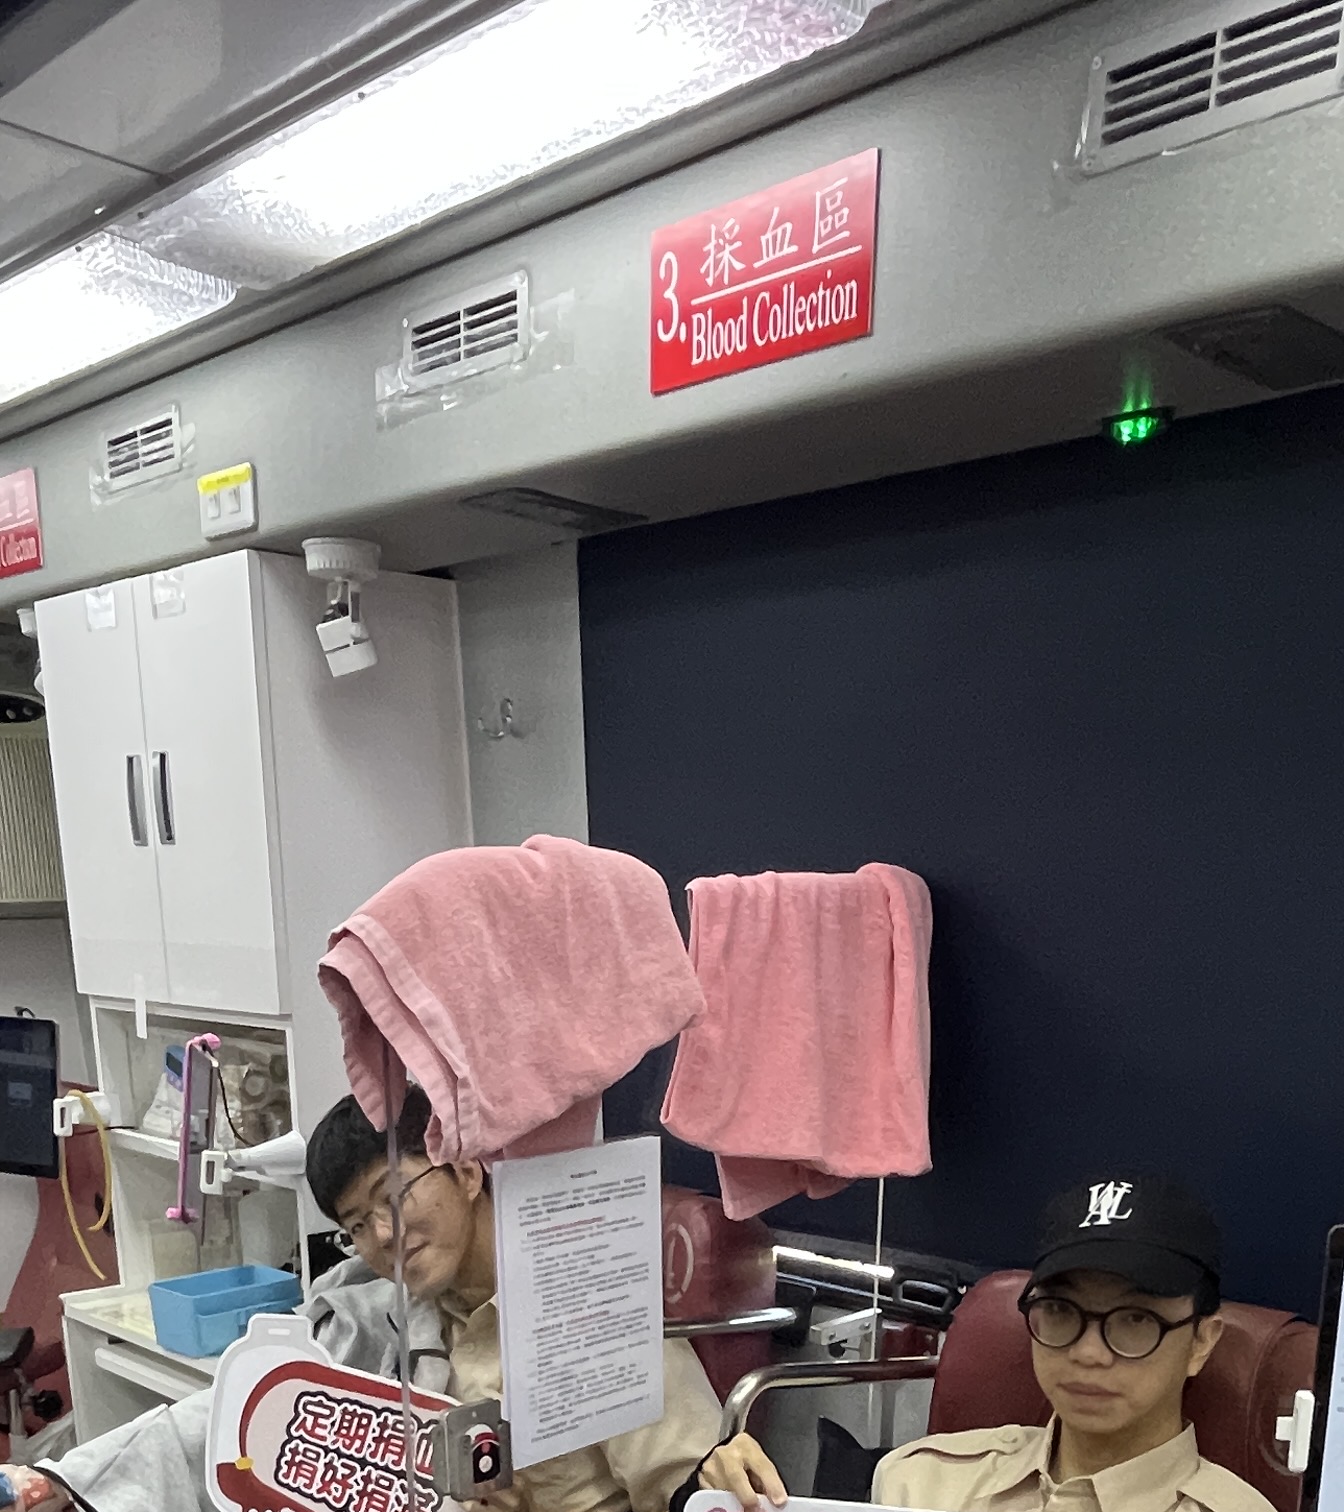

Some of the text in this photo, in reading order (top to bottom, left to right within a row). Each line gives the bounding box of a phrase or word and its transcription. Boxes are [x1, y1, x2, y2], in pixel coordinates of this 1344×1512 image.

[699, 176, 851, 288] 採血區
[656, 250, 688, 344] 3.
[690, 268, 859, 367] Blood Collection
